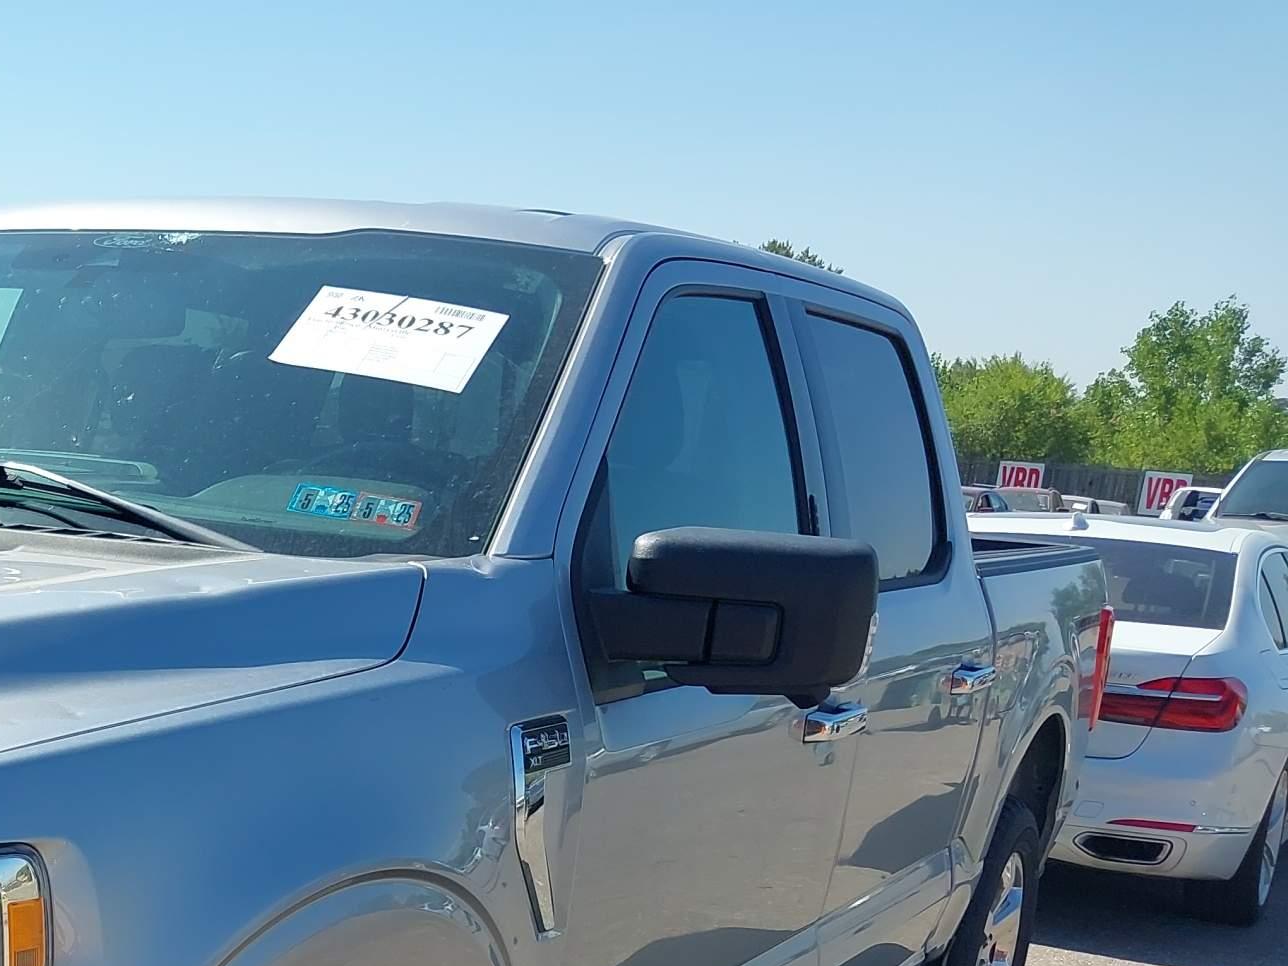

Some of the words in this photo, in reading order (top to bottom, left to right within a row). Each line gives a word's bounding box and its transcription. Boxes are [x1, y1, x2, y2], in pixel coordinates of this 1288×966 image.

[324, 305, 476, 339] 43030287
[301, 493, 316, 511] 5
[333, 493, 354, 514] 25
[362, 502, 375, 520] 5
[397, 503, 415, 524] 25
[524, 730, 569, 755] F-150
